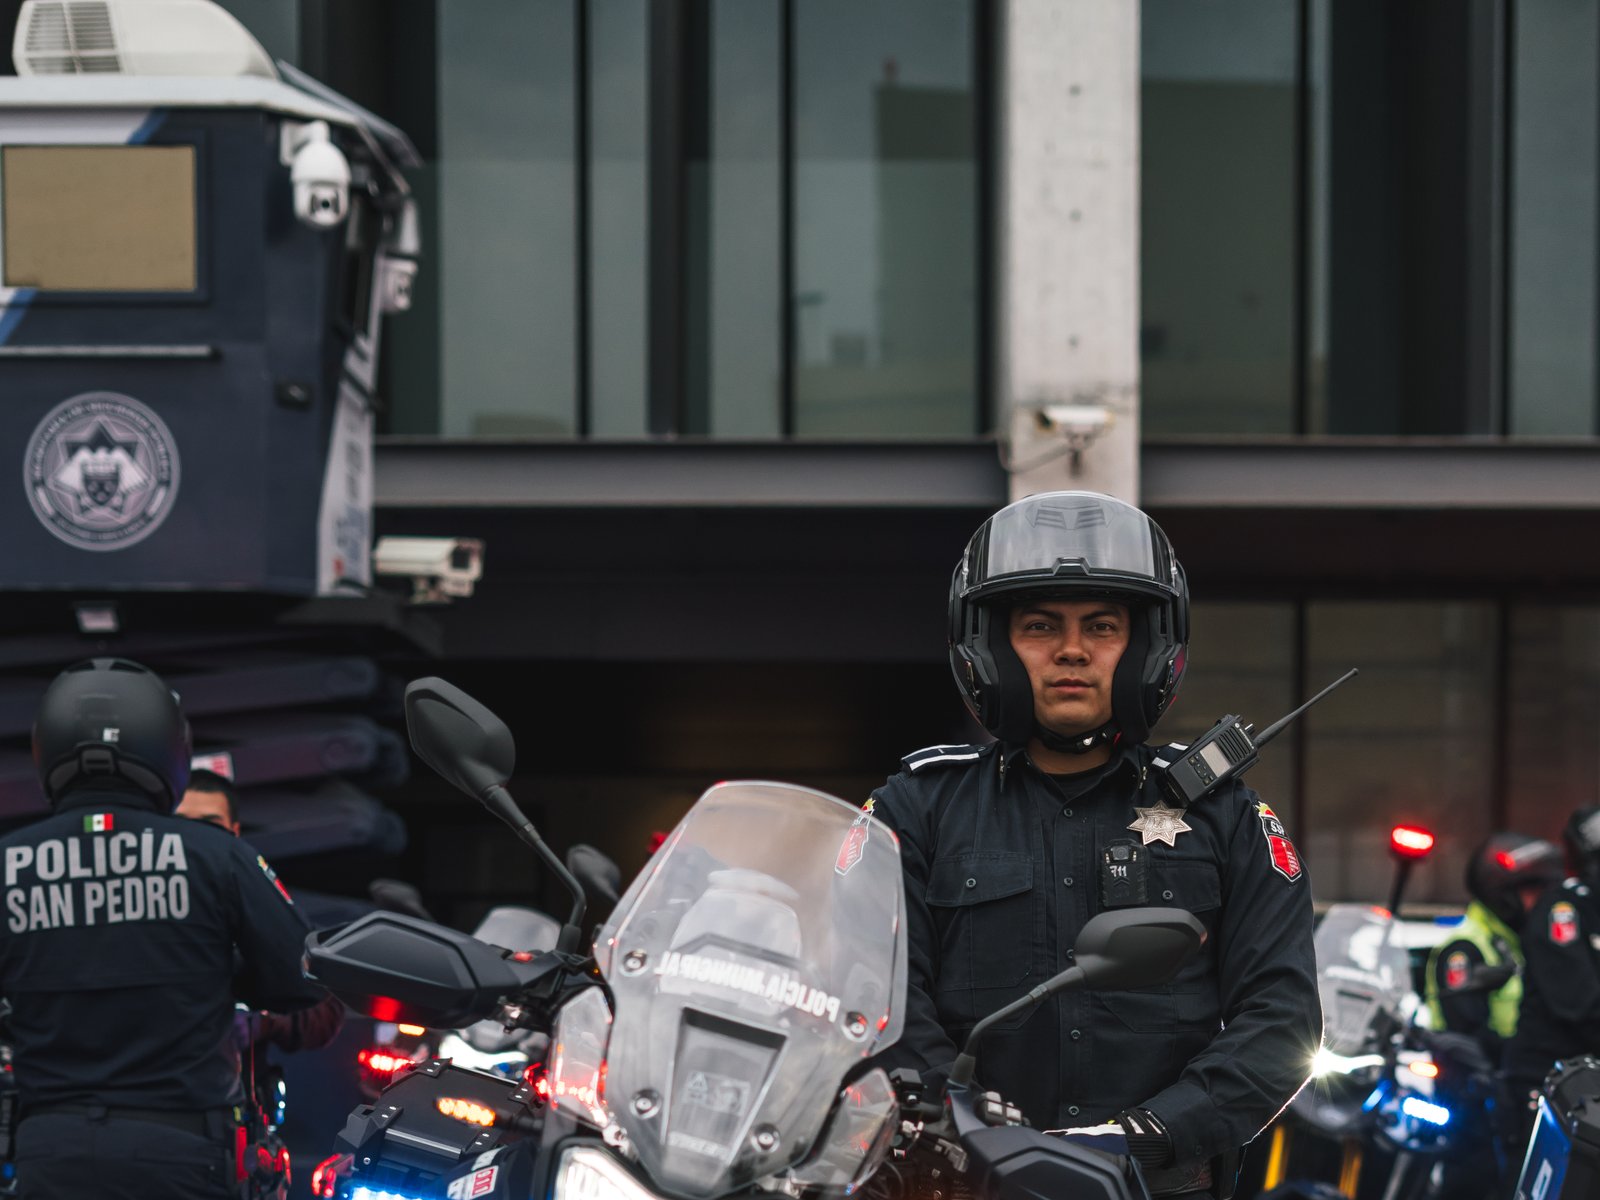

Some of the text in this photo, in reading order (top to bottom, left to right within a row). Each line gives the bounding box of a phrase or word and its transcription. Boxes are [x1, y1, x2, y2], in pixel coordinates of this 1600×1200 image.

[5, 828, 188, 886] POLICÍA
[1109, 865, 1127, 877] 711
[6, 874, 190, 934] SAN PEDRO
[474, 1170, 493, 1194] 911
